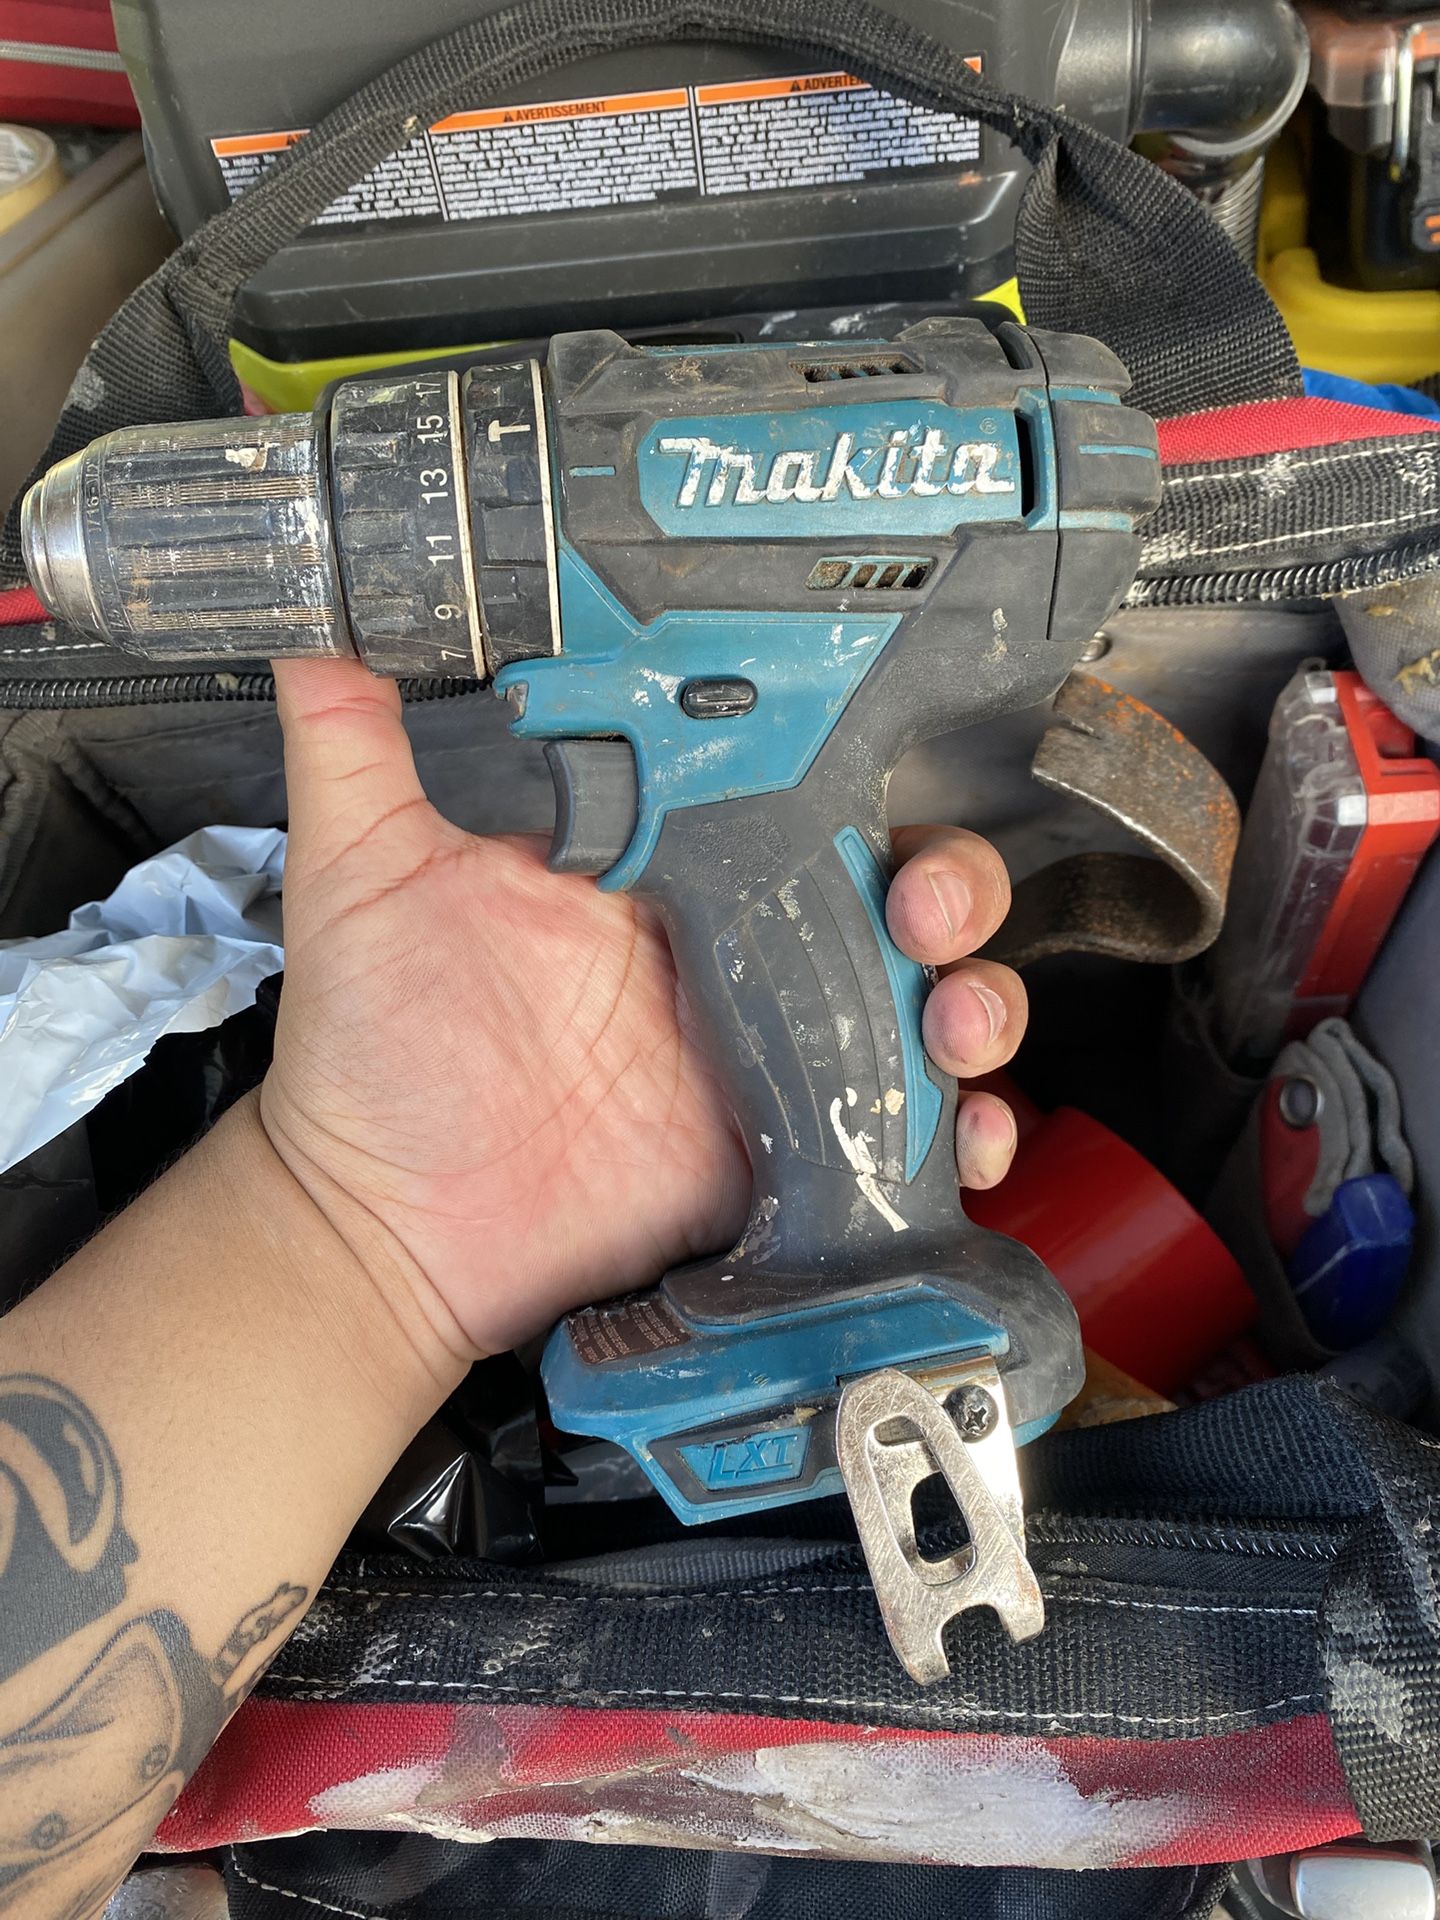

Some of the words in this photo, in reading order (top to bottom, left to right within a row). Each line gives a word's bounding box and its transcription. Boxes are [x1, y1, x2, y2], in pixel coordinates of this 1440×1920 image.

[515, 101, 606, 121] AVERTISSEMENT
[416, 382, 441, 398] 17
[417, 415, 444, 444] 15
[420, 468, 448, 504] 13
[425, 535, 455, 567] 11
[434, 604, 462, 620] 9
[441, 650, 467, 661] 7
[707, 1434, 798, 1482] LXT
